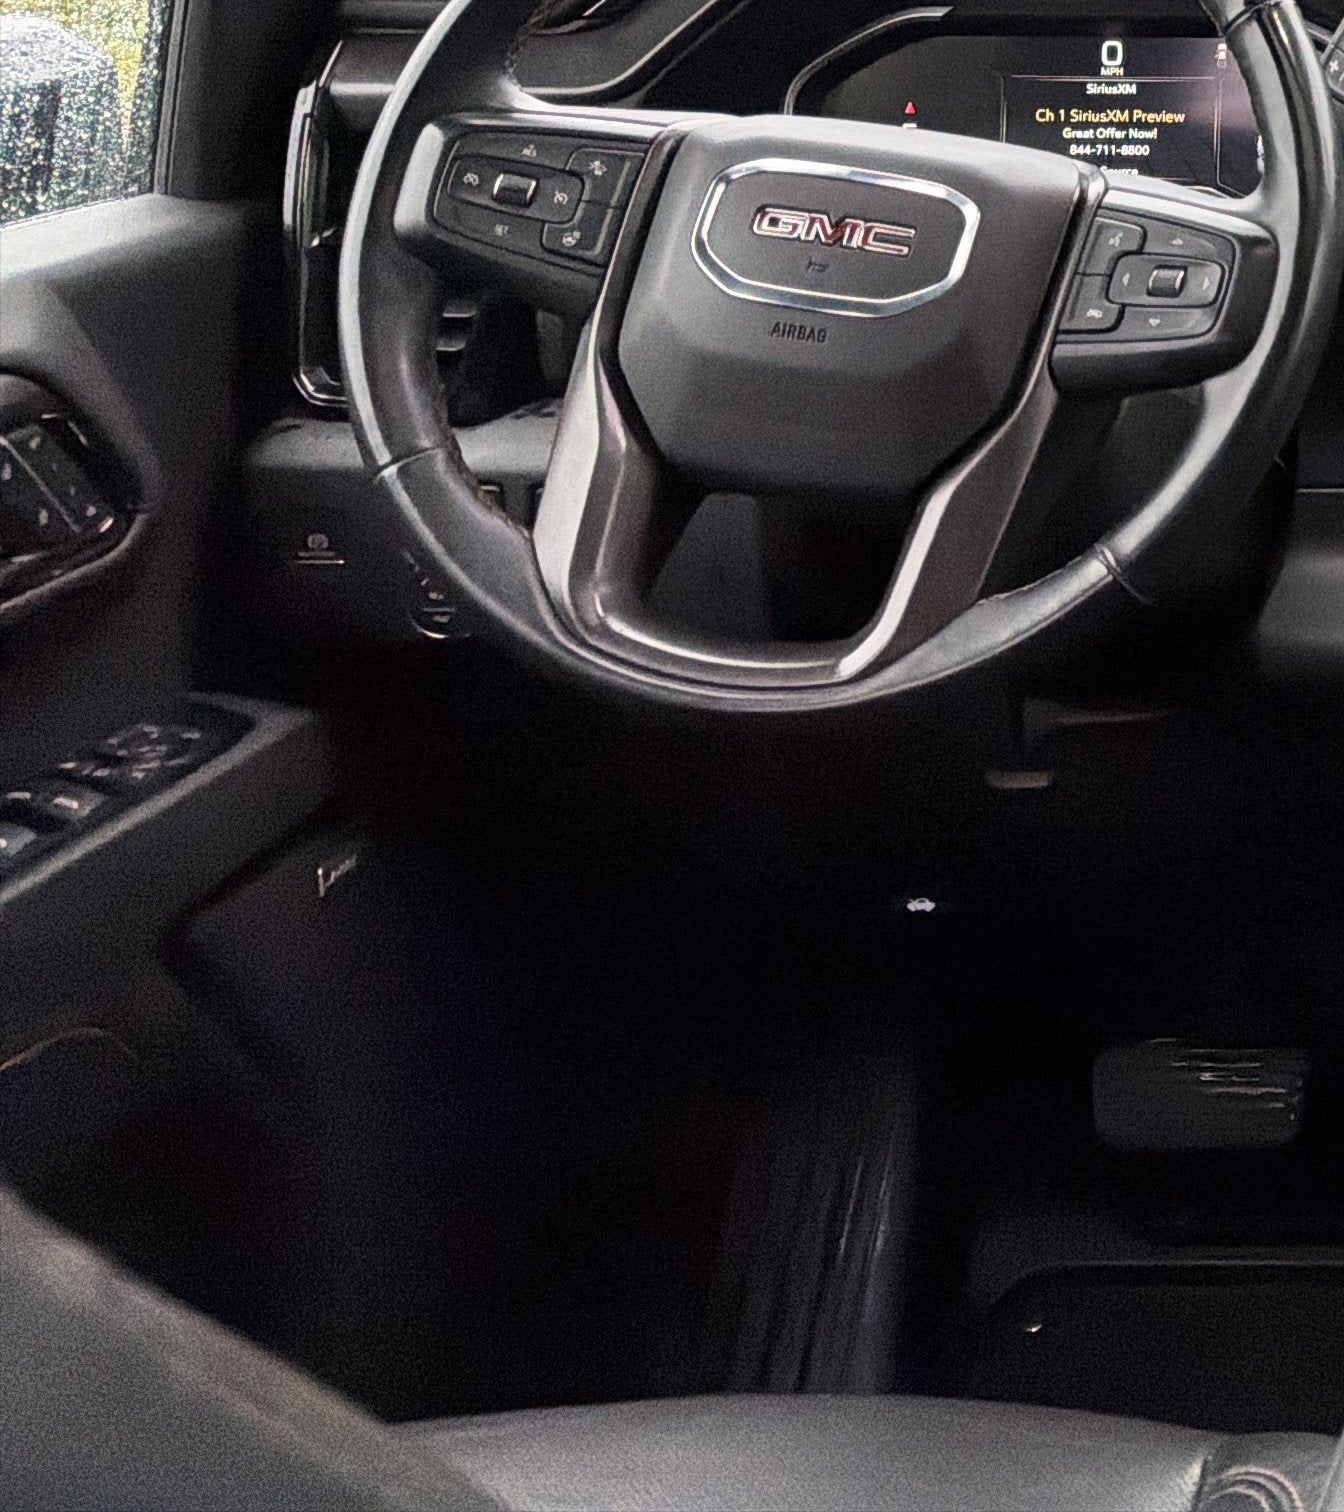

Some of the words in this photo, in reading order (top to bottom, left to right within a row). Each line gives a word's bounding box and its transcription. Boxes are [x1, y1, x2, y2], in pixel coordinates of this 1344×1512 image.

[1101, 40, 1123, 66] 0
[1100, 67, 1124, 76] MPH
[1086, 84, 1137, 95] SiriusXM
[1035, 108, 1055, 122] Ch
[1058, 109, 1065, 122] 1
[1070, 109, 1130, 123] SiriusXM
[1132, 110, 1186, 123] Preview
[1062, 127, 1094, 139] Great
[1096, 127, 1127, 139] Offer
[1129, 128, 1158, 139] Now!
[1069, 145, 1150, 156] 844-711-8800
[752, 206, 917, 256] GMC
[769, 320, 828, 343] AIRBAG
